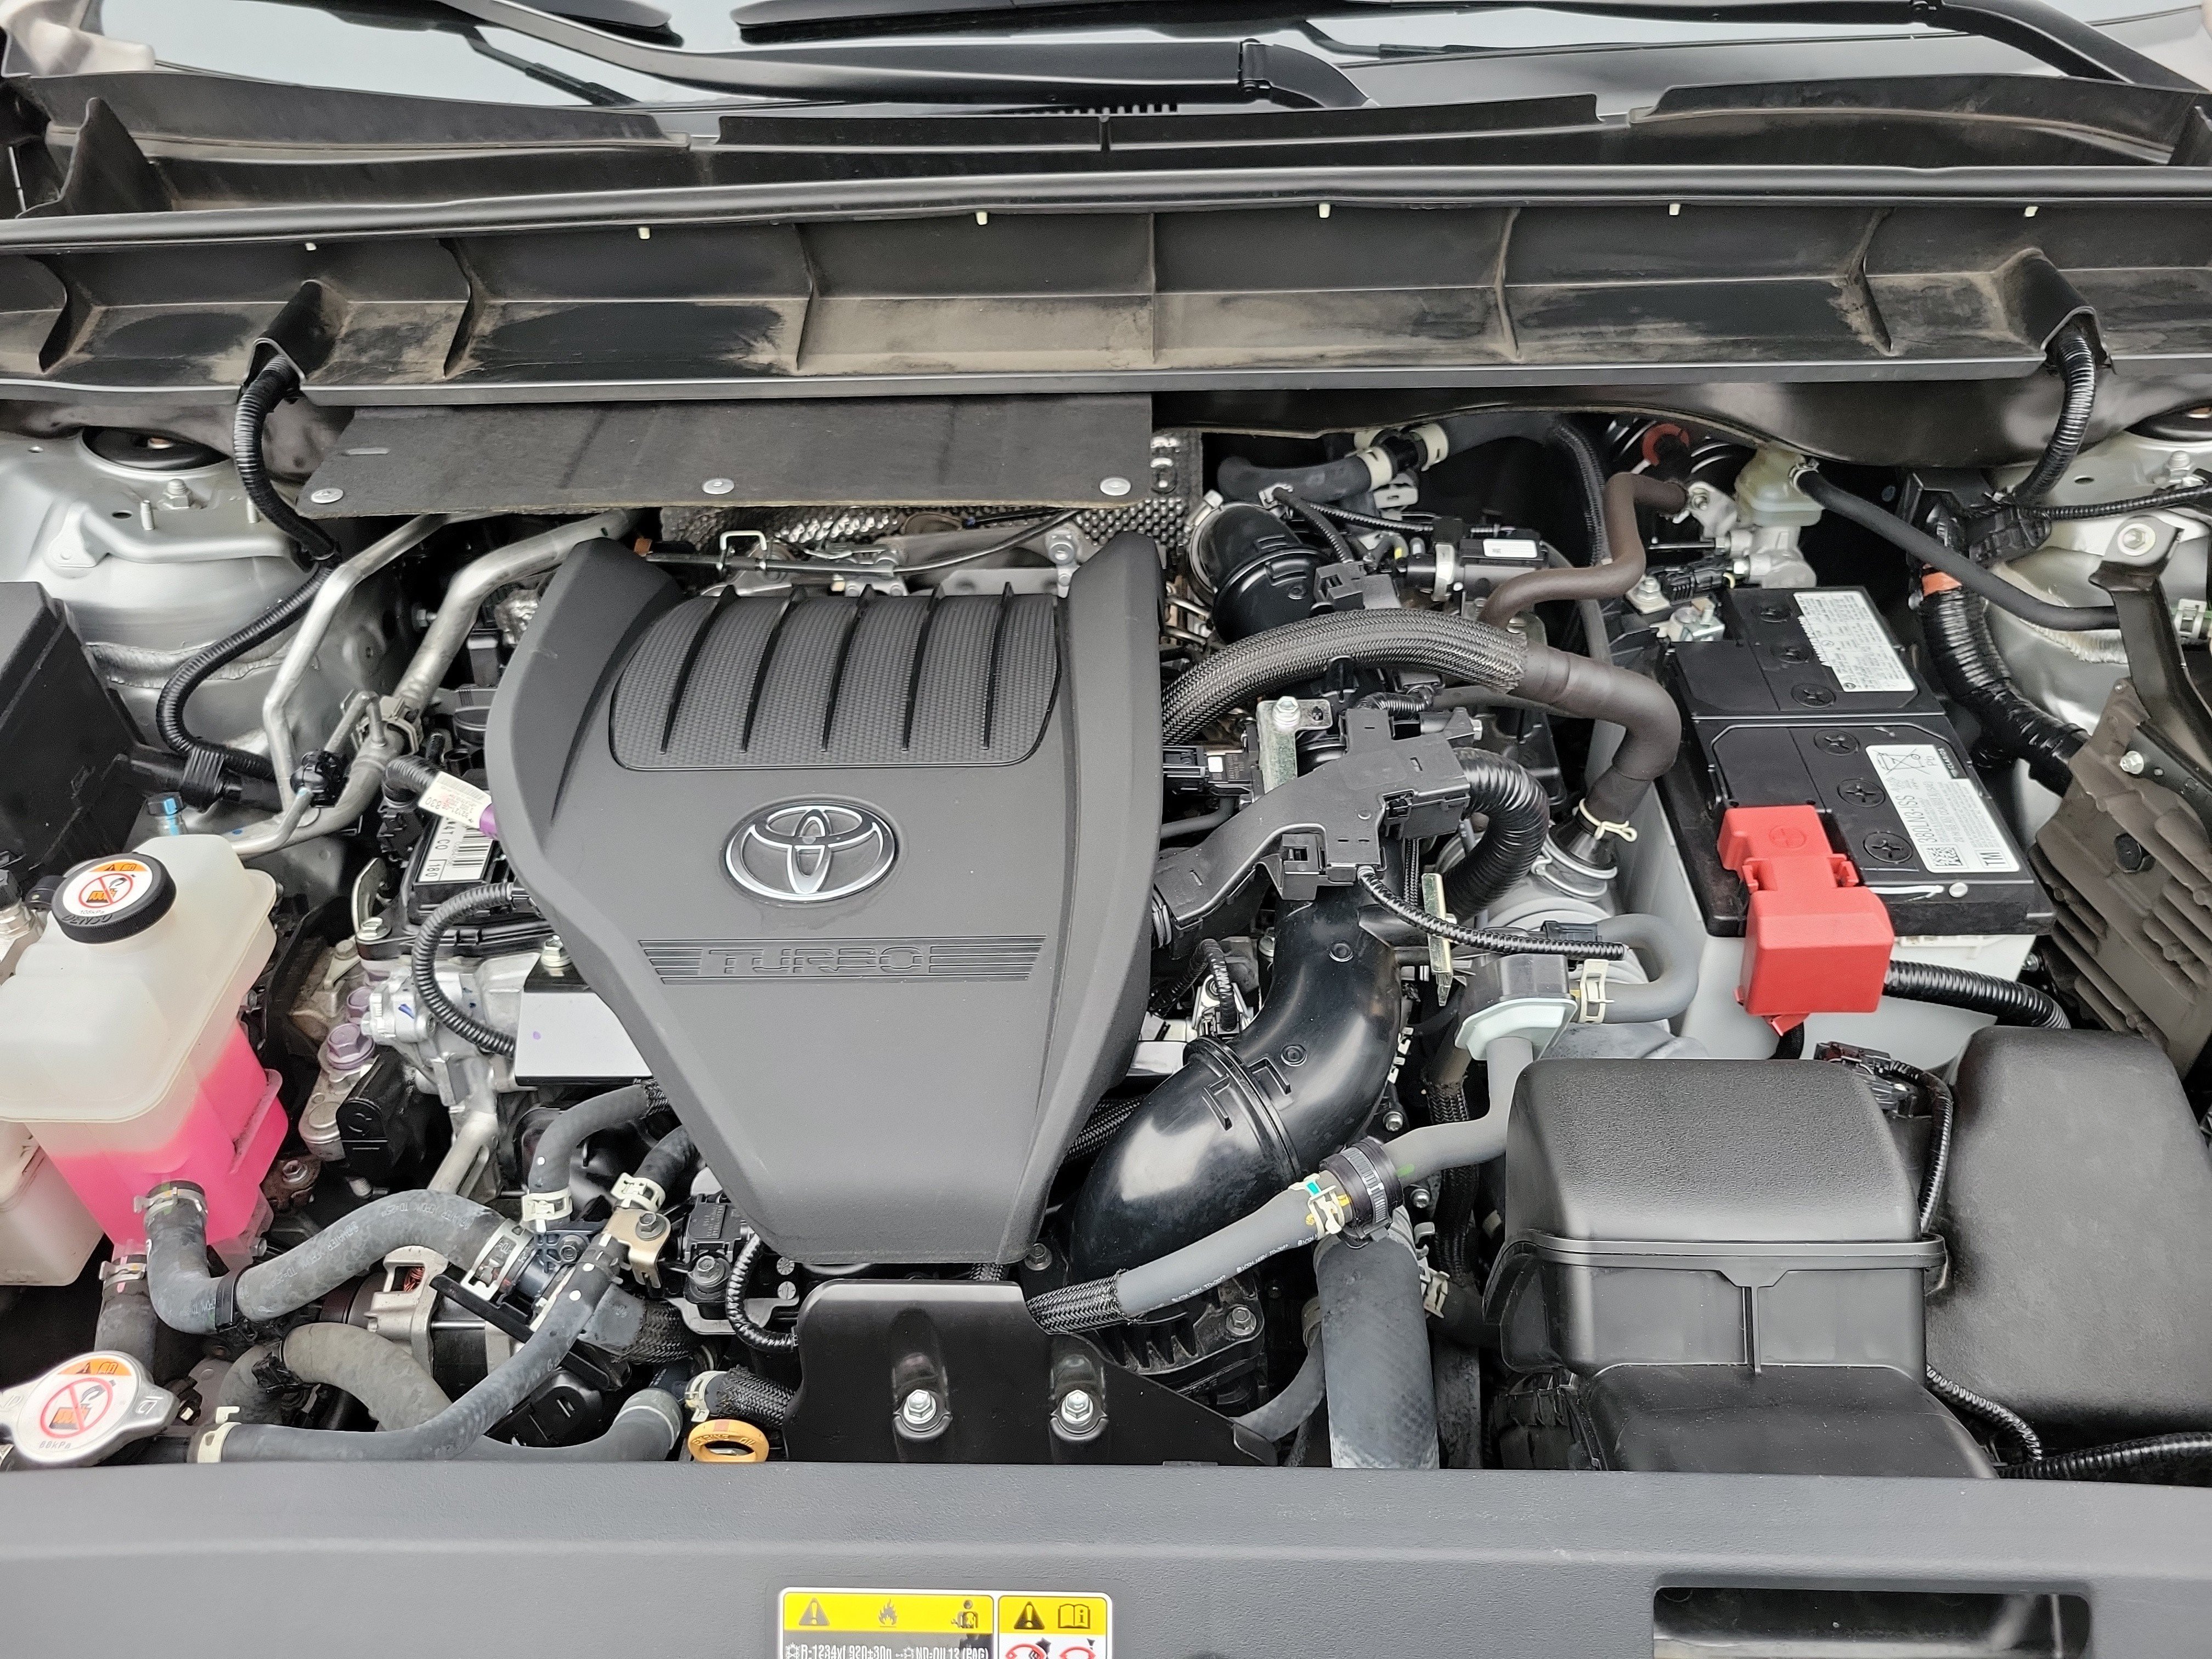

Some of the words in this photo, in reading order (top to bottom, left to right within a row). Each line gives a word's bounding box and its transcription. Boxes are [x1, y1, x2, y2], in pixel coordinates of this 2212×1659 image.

[1980, 851, 2006, 866] TM
[61, 913, 113, 926] DENSO
[708, 945, 924, 974] TURBO
[692, 1434, 730, 1446] ENGINE
[738, 1437, 757, 1447] OIL
